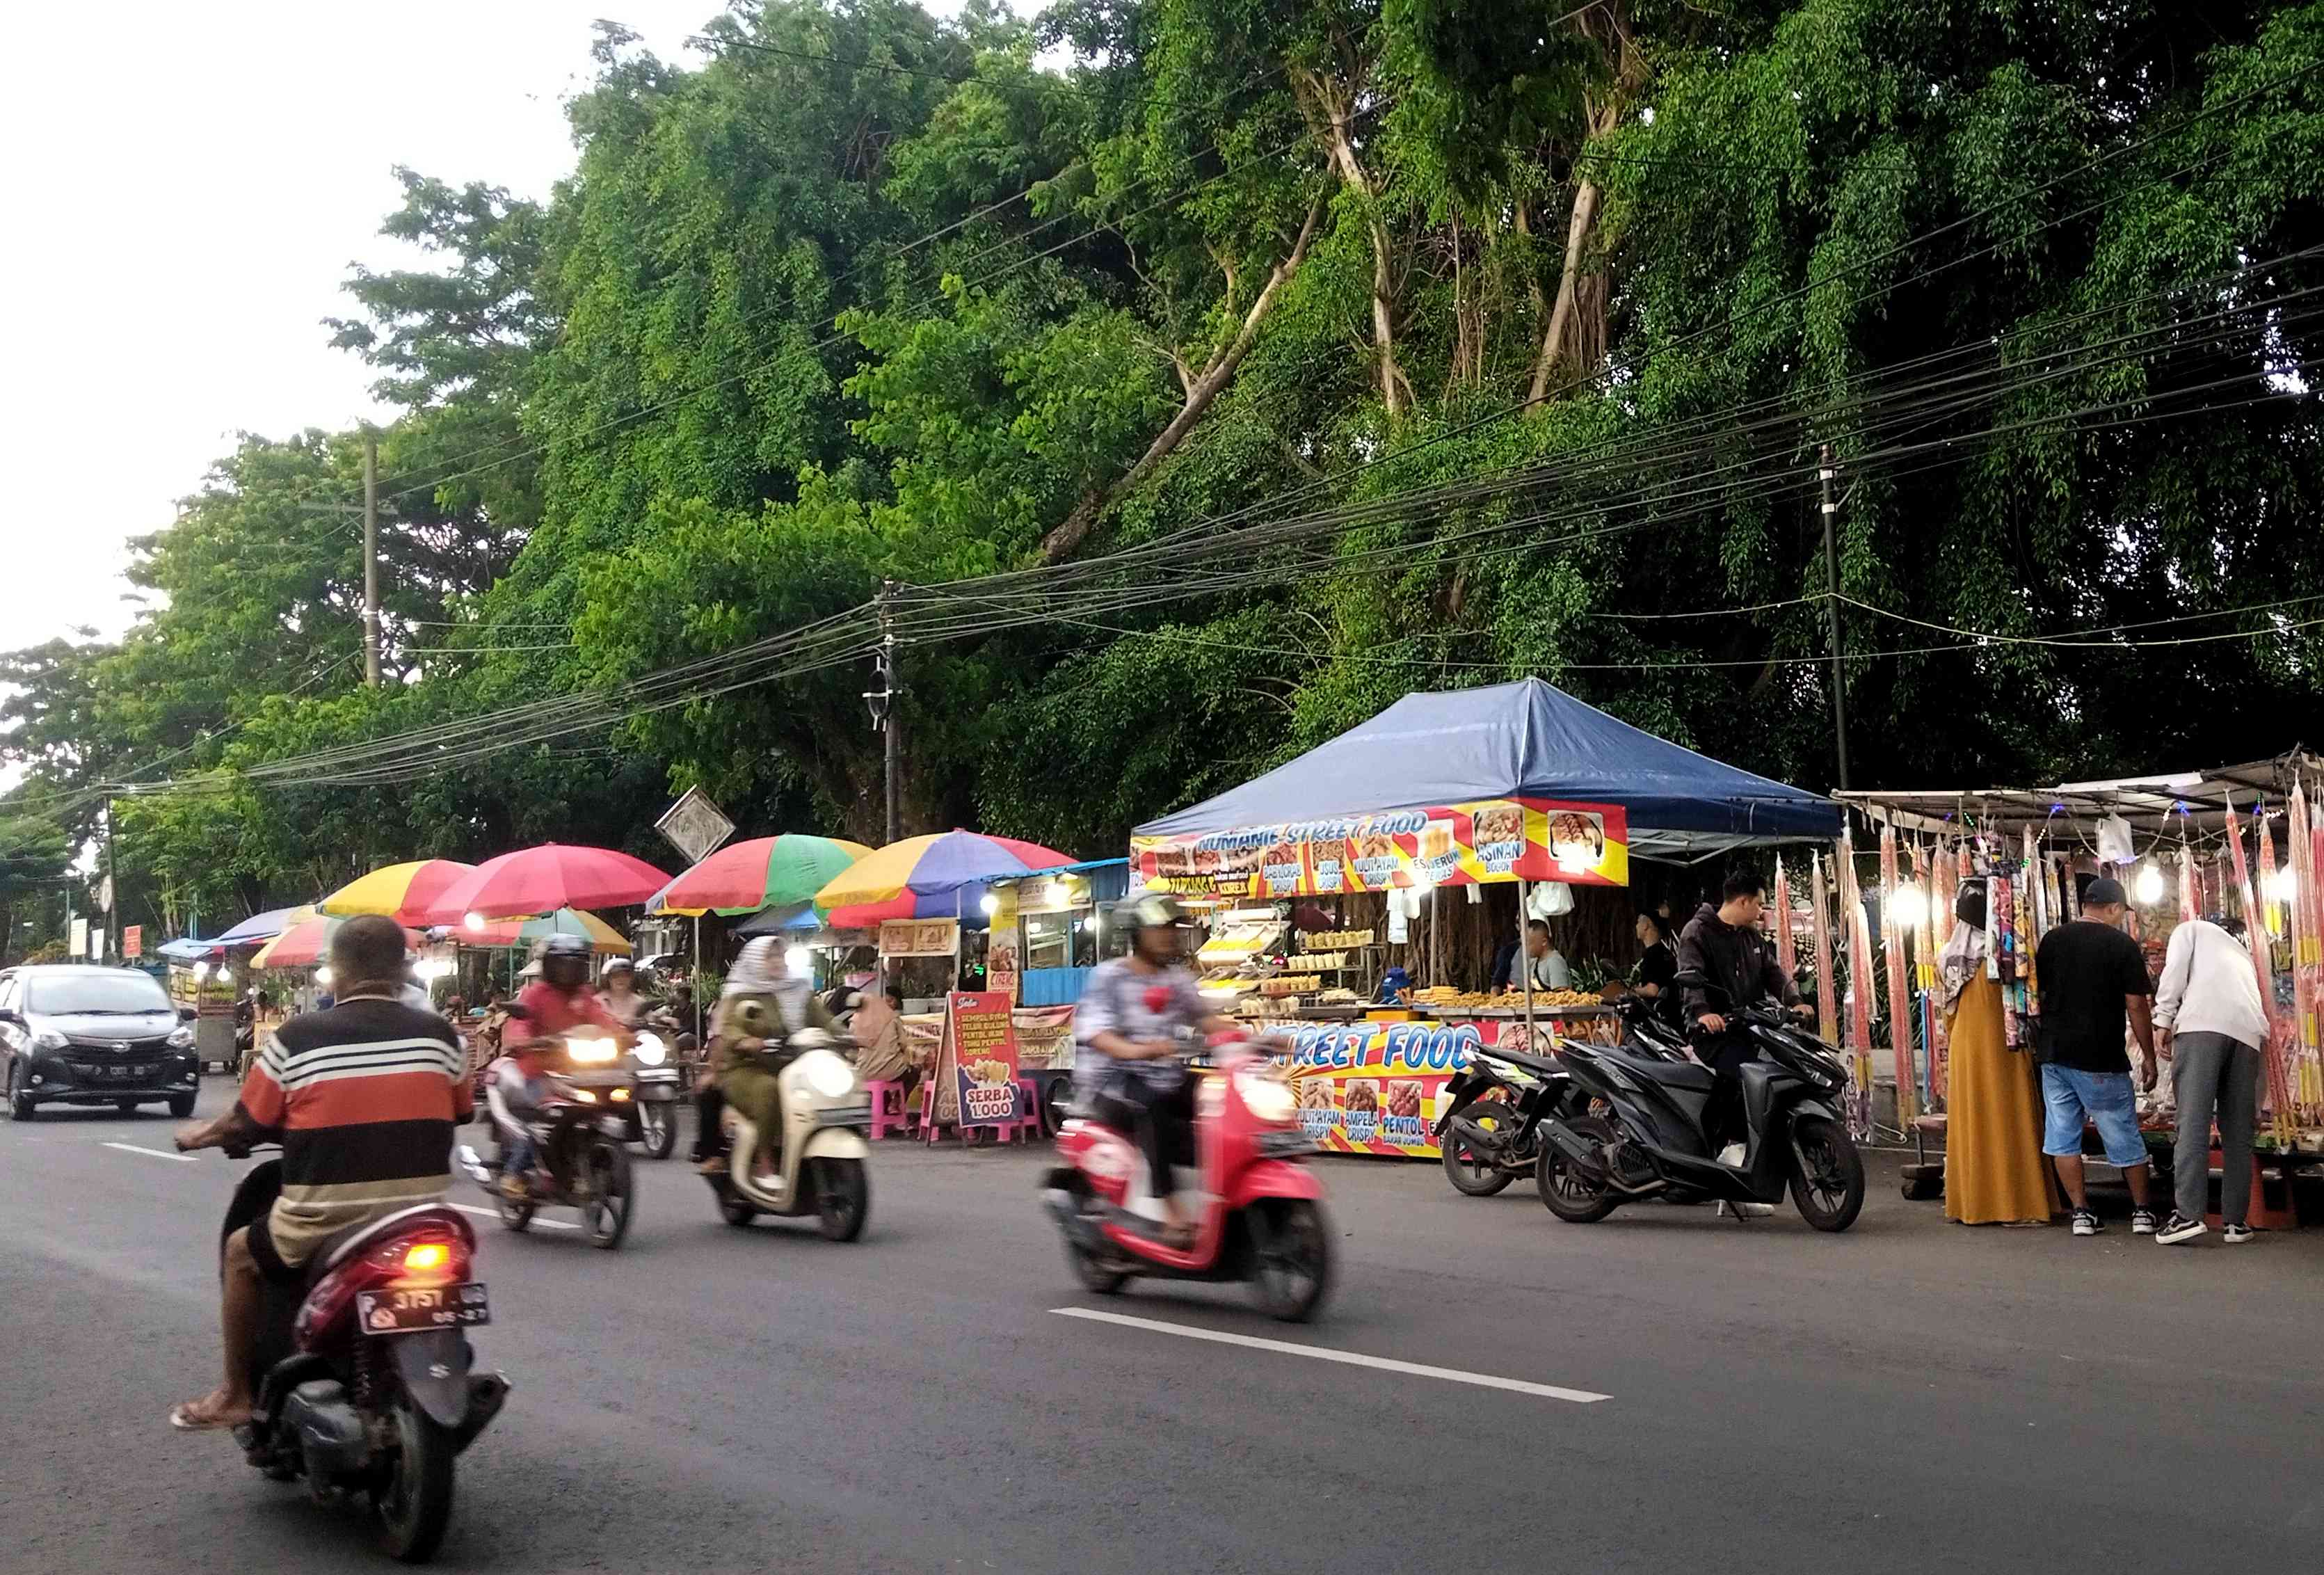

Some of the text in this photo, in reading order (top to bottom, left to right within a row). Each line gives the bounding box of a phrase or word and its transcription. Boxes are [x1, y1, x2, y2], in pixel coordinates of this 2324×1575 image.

[1286, 818, 1360, 843] STREET
[1367, 813, 1427, 837] FOOD
[1413, 849, 1461, 870] ES JERUK
[1477, 842, 1521, 863] ASINAN
[1320, 861, 1339, 874] USUS
[1375, 857, 1399, 872] AYAM
[1319, 875, 1342, 888] CRISPY
[1365, 873, 1391, 886] CRISPY
[1217, 881, 1248, 895] KOREA
[1383, 1023, 1480, 1070] FOOD
[967, 1087, 1013, 1103] SERBA
[1317, 1110, 1340, 1125] AYAM
[1345, 1111, 1379, 1128] AMPELA
[1383, 1116, 1425, 1135] PENTOL
[1347, 1126, 1375, 1142] CRISPY
